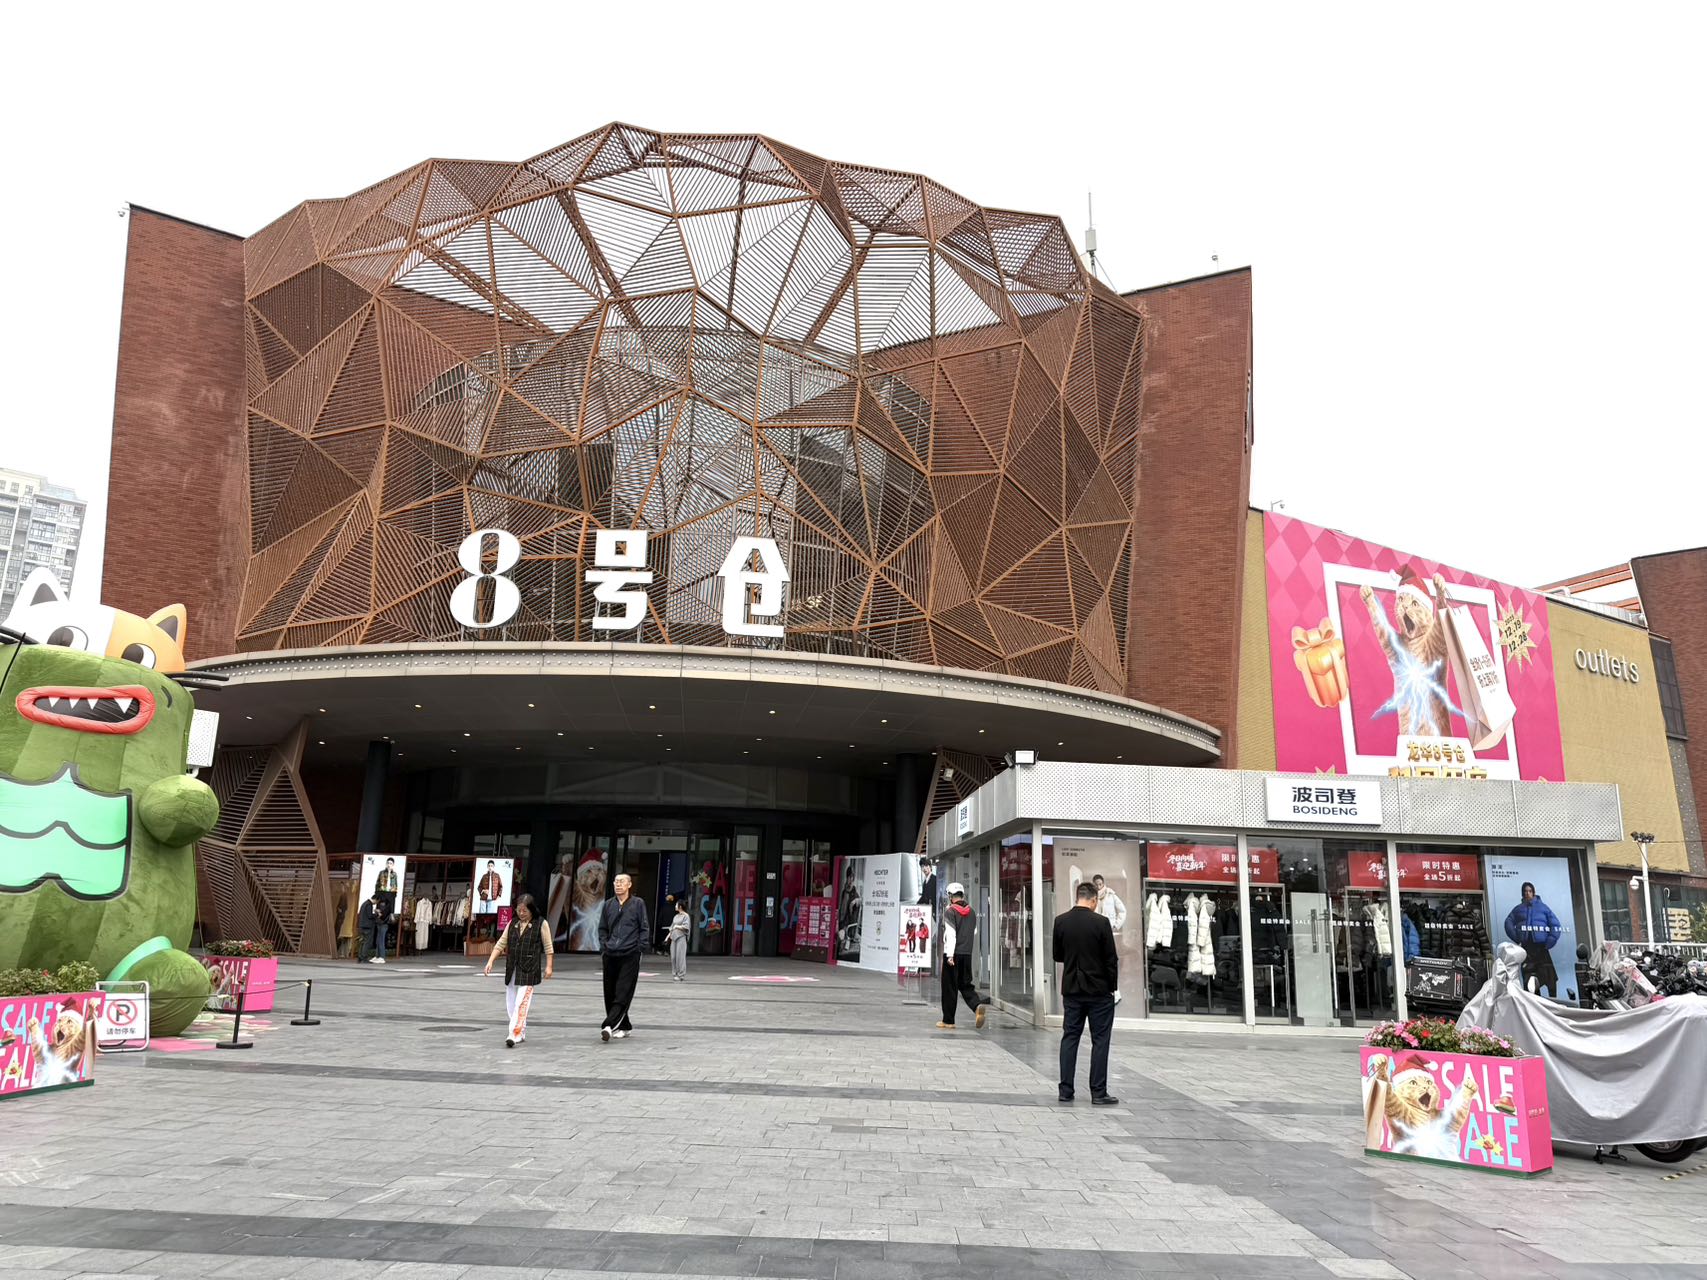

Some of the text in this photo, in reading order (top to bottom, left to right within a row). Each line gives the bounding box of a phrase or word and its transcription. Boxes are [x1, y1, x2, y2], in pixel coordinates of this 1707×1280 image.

[450, 529, 791, 637] 8号仓
[1504, 619, 1522, 638] 12.19
[1508, 631, 1528, 653] 12.28
[1407, 741, 1466, 763] 龙华8号仓
[1292, 786, 1357, 804] 波司登
[1292, 805, 1358, 816] BOSIDENG
[1421, 861, 1461, 870] 限时特惠
[1423, 871, 1461, 881] 全场5折起
[699, 895, 754, 932] SALE
[223, 960, 249, 985] SALE
[106, 1027, 137, 1036] 请勿停车
[1441, 1061, 1517, 1117] SALE
[1457, 1111, 1523, 1168] ALE
